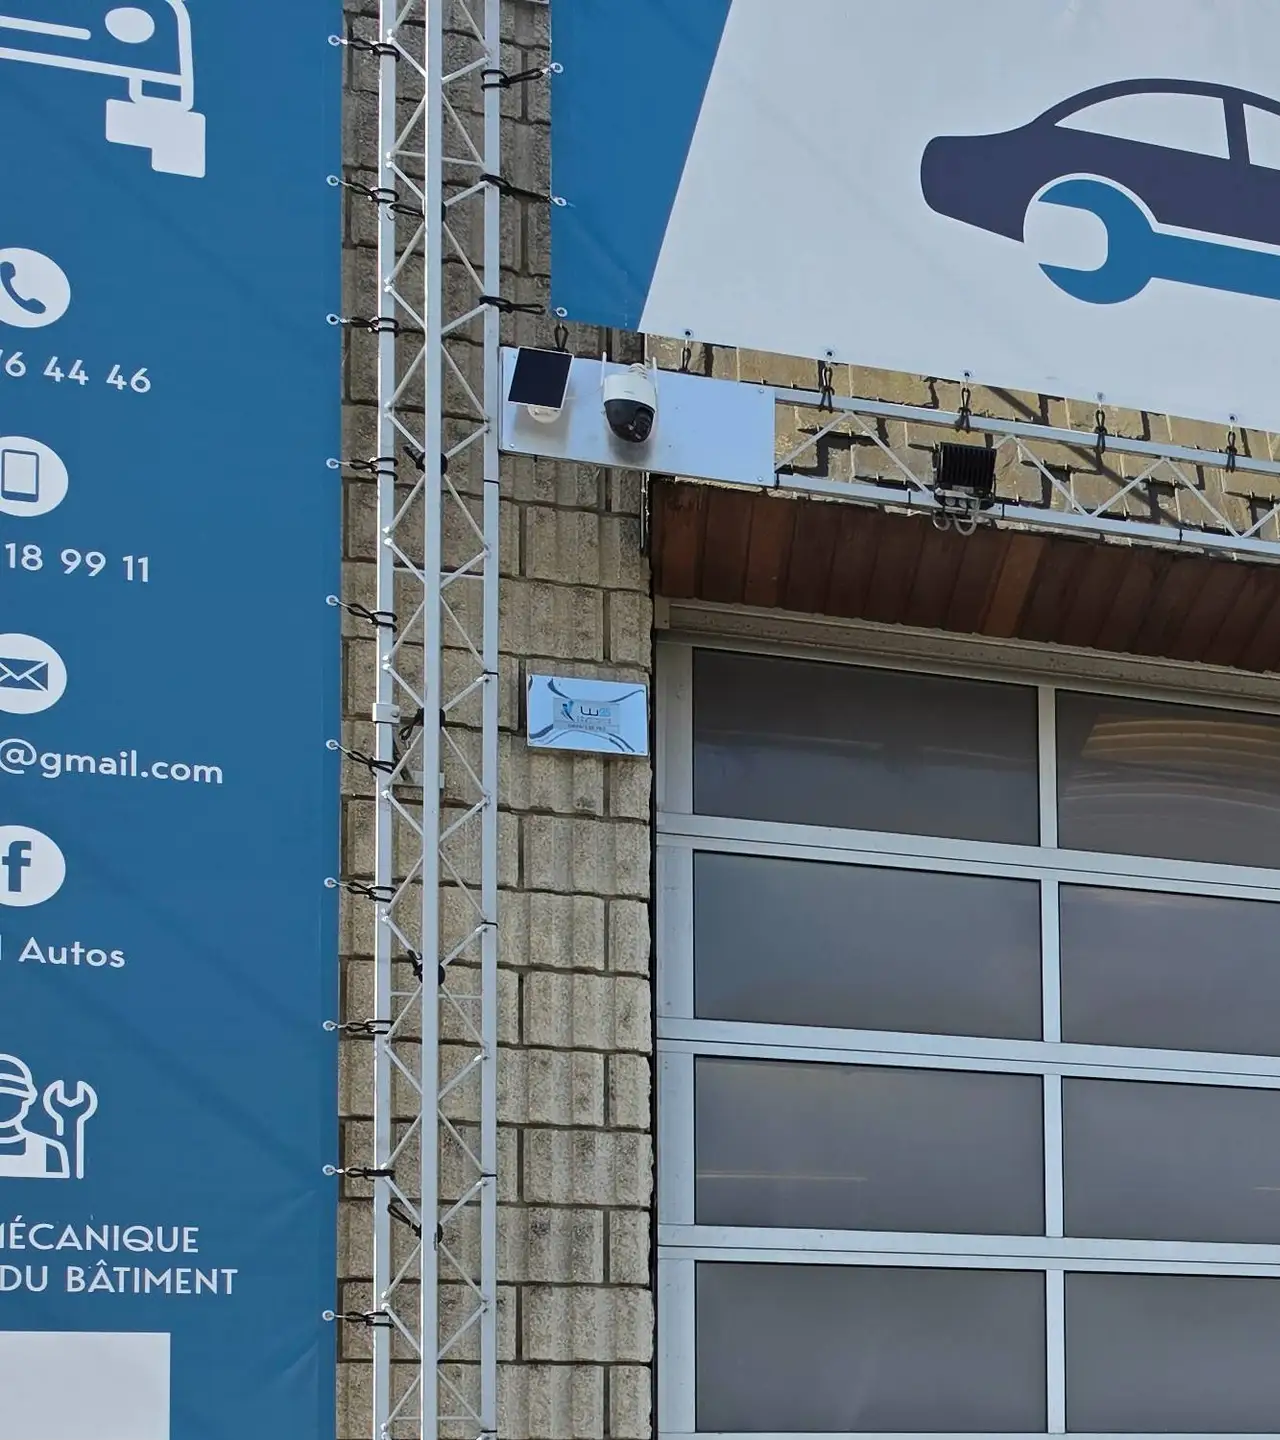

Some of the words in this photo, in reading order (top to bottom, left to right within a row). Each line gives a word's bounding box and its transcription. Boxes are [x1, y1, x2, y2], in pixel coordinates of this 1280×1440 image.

[0, 349, 26, 377] 6
[43, 356, 89, 385] 44
[106, 364, 151, 393] 46
[5, 543, 43, 571] 18
[61, 549, 106, 577] 99
[123, 555, 149, 582] 11
[0, 738, 223, 784] @gmail.com
[18, 937, 125, 968] Autos
[0, 1215, 199, 1253] ÉCANIQUE
[0, 1264, 48, 1291] DU
[67, 1259, 238, 1294] BÂTIMENT
